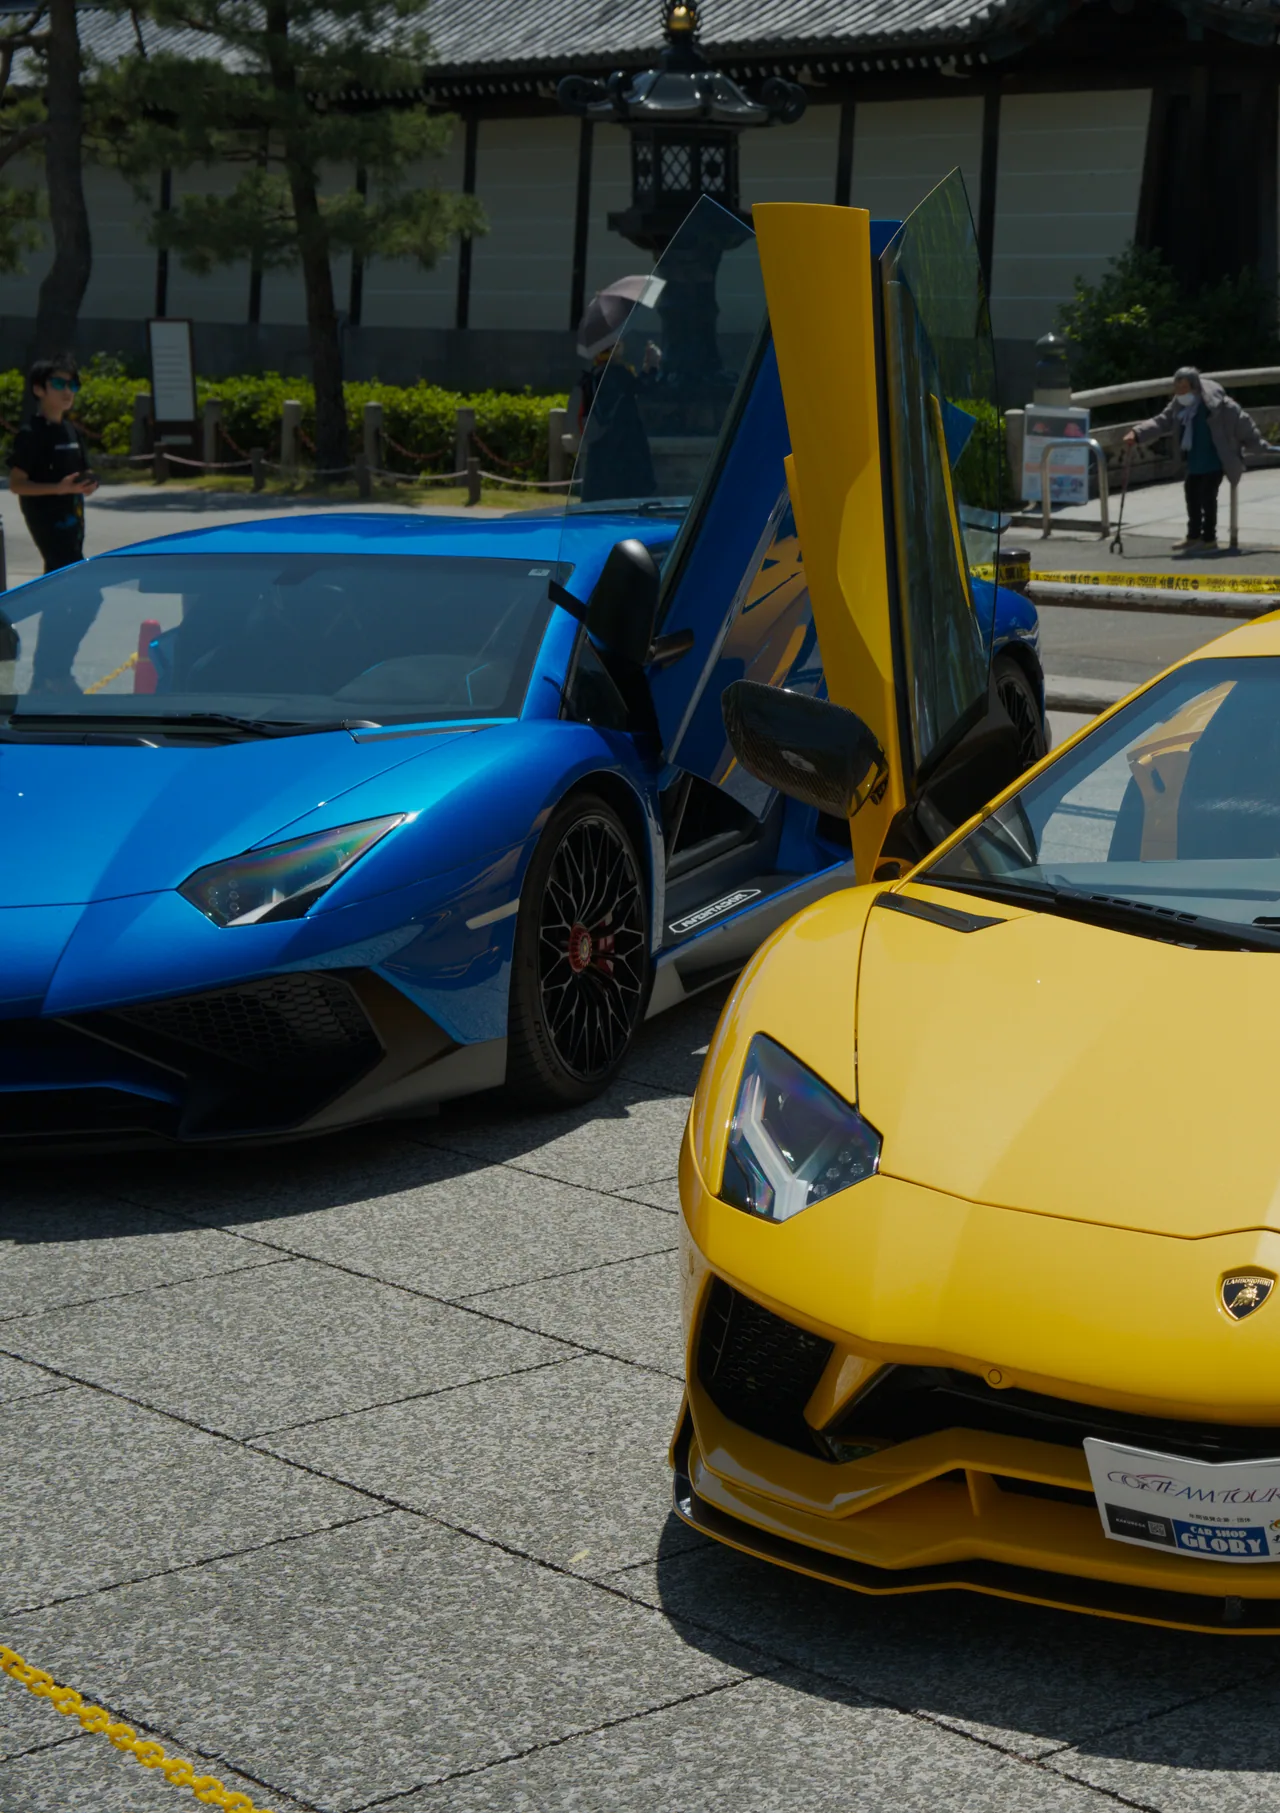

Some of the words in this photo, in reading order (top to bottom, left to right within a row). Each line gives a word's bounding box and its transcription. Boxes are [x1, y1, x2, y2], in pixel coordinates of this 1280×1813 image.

[1226, 1278, 1270, 1287] LAMBORGHINI
[1190, 1526, 1212, 1537] CAR
[1215, 1527, 1247, 1538] SHOP
[1180, 1532, 1262, 1553] GLORY
